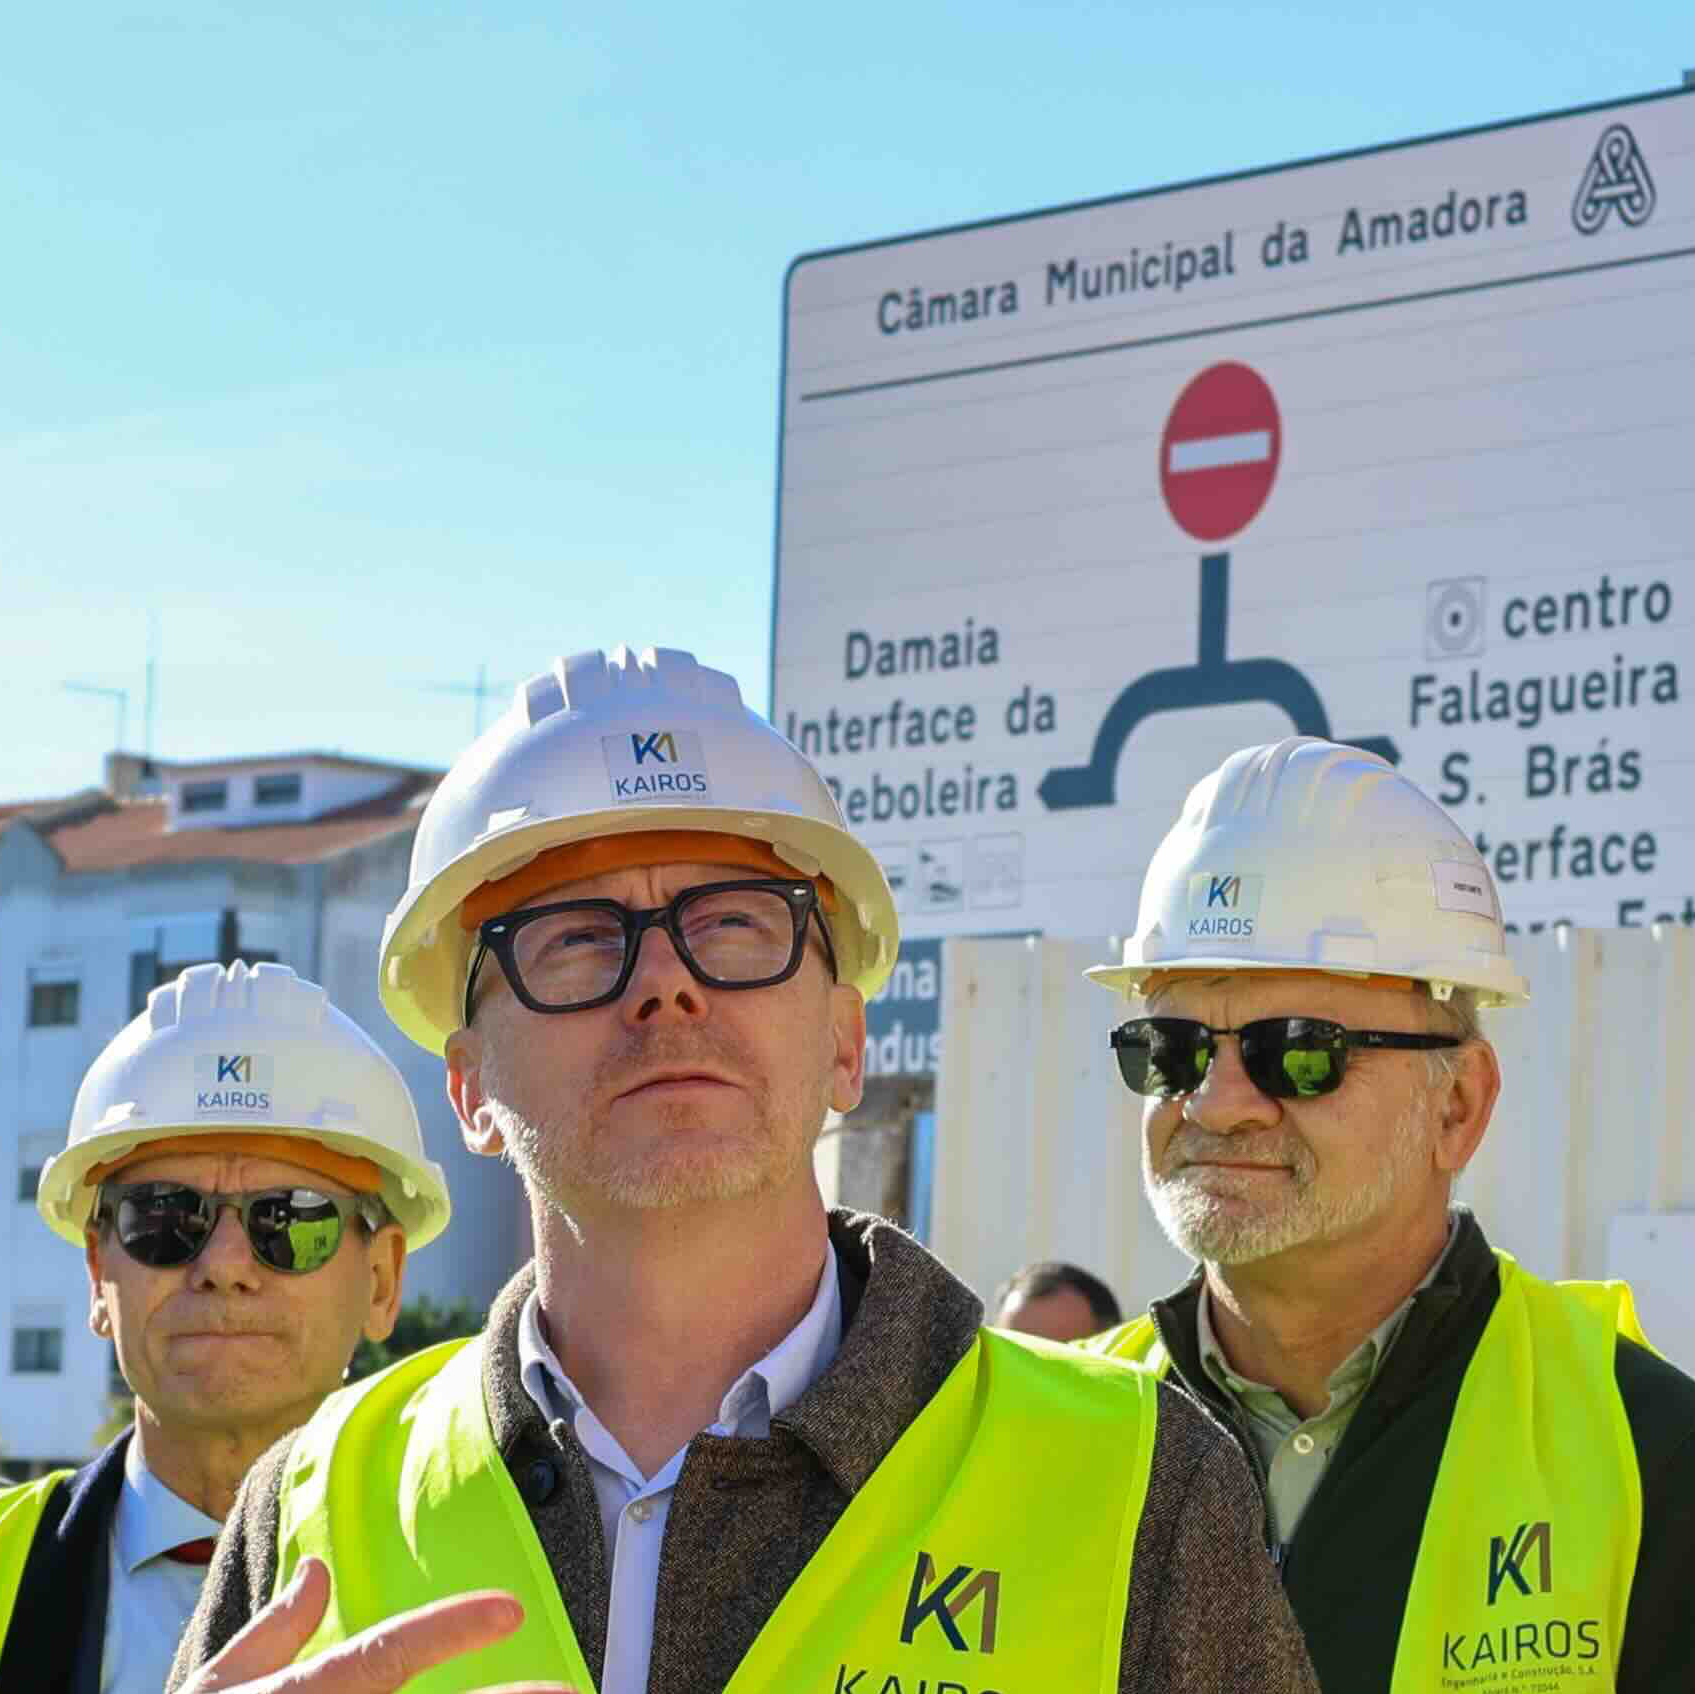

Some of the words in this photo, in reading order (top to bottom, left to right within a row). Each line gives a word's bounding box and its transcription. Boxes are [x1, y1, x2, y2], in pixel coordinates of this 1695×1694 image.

[877, 279, 1019, 335] Câmara
[1045, 231, 1235, 306] Municipal
[1261, 219, 1309, 267] da
[1337, 187, 1528, 256] Amadora
[1502, 573, 1673, 639] centro
[844, 616, 1000, 680] Damaia
[785, 700, 977, 757] Interface
[1006, 684, 1057, 737] da
[1409, 652, 1679, 730] Falagueira
[615, 773, 707, 796] KAIROS
[1438, 750, 1486, 806] S.
[1525, 737, 1642, 799] Brás
[1188, 917, 1253, 937] KAIROS
[196, 1091, 270, 1110] KAIROS
[1442, 1619, 1601, 1671] KAIROS
